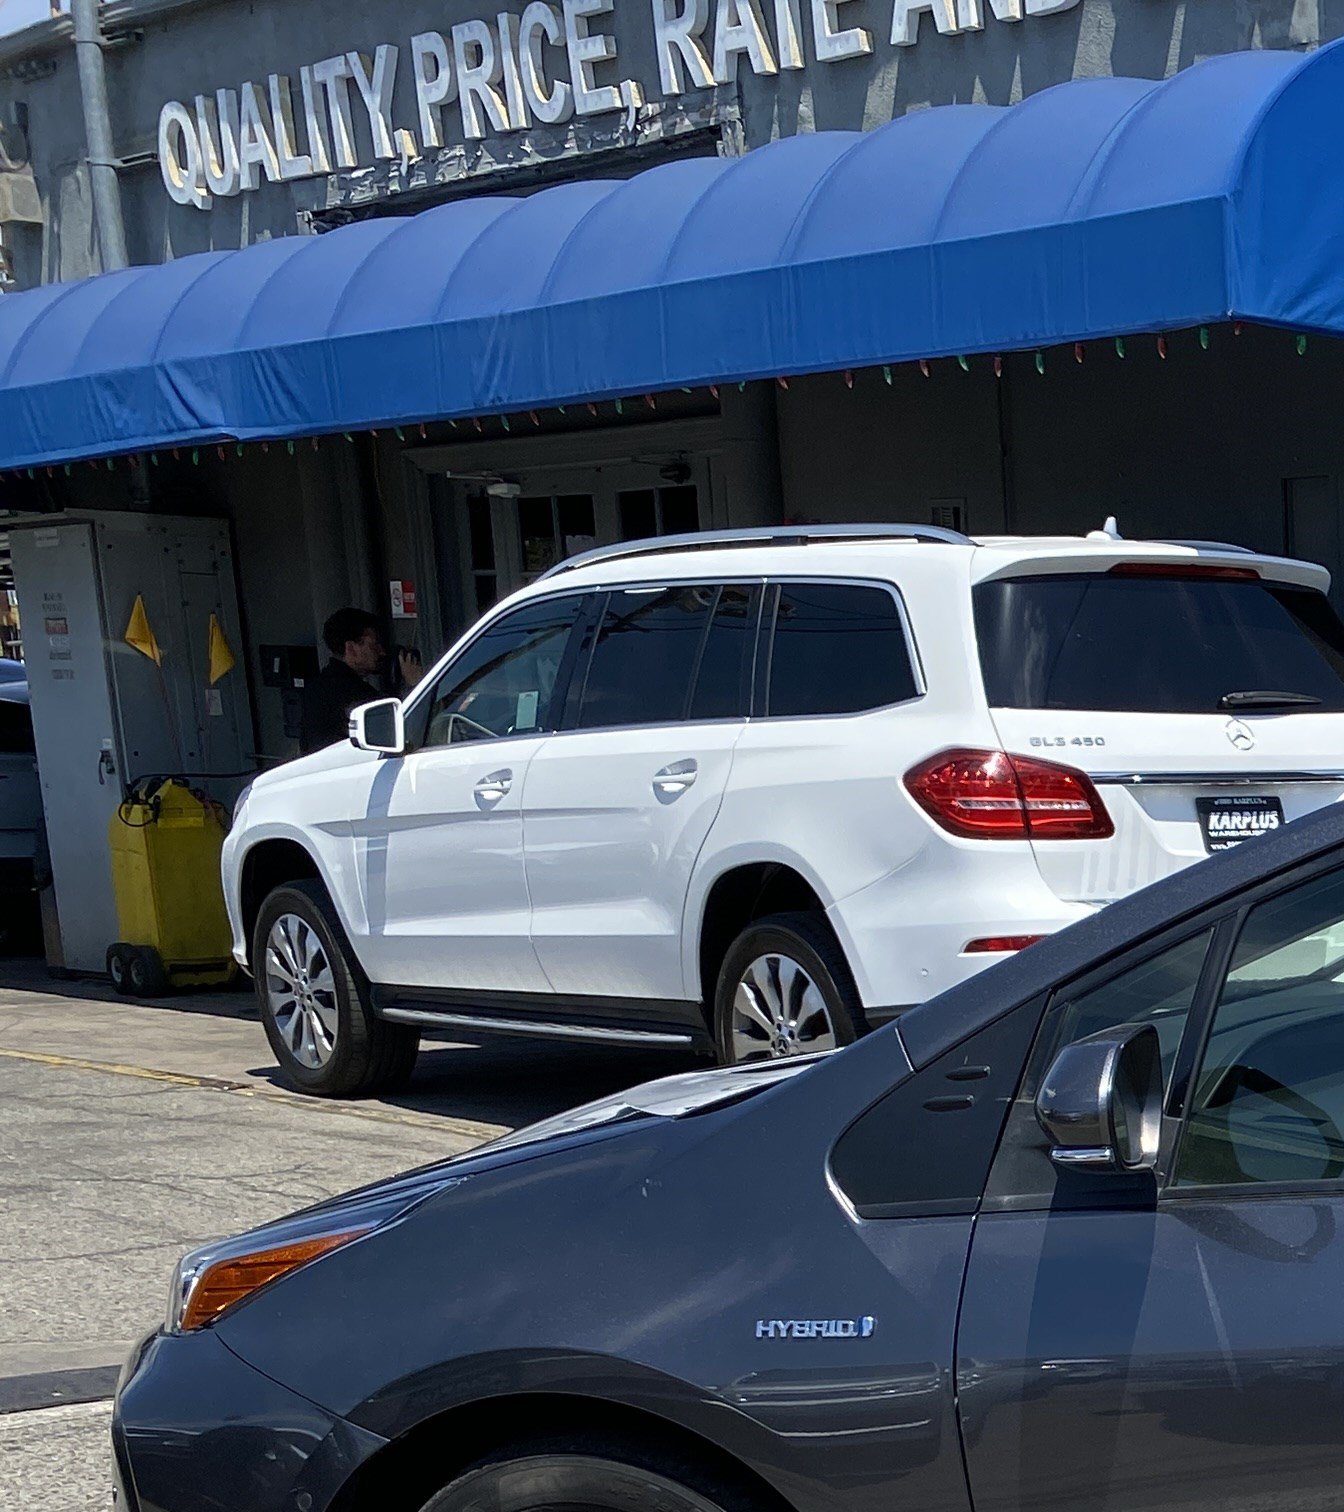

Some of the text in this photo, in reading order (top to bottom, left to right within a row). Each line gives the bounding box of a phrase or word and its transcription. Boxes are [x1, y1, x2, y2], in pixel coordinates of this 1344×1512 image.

[1029, 736, 1106, 747] GLS 450
[1208, 810, 1280, 830] KARPLUS
[755, 1319, 858, 1338] HYBRID
